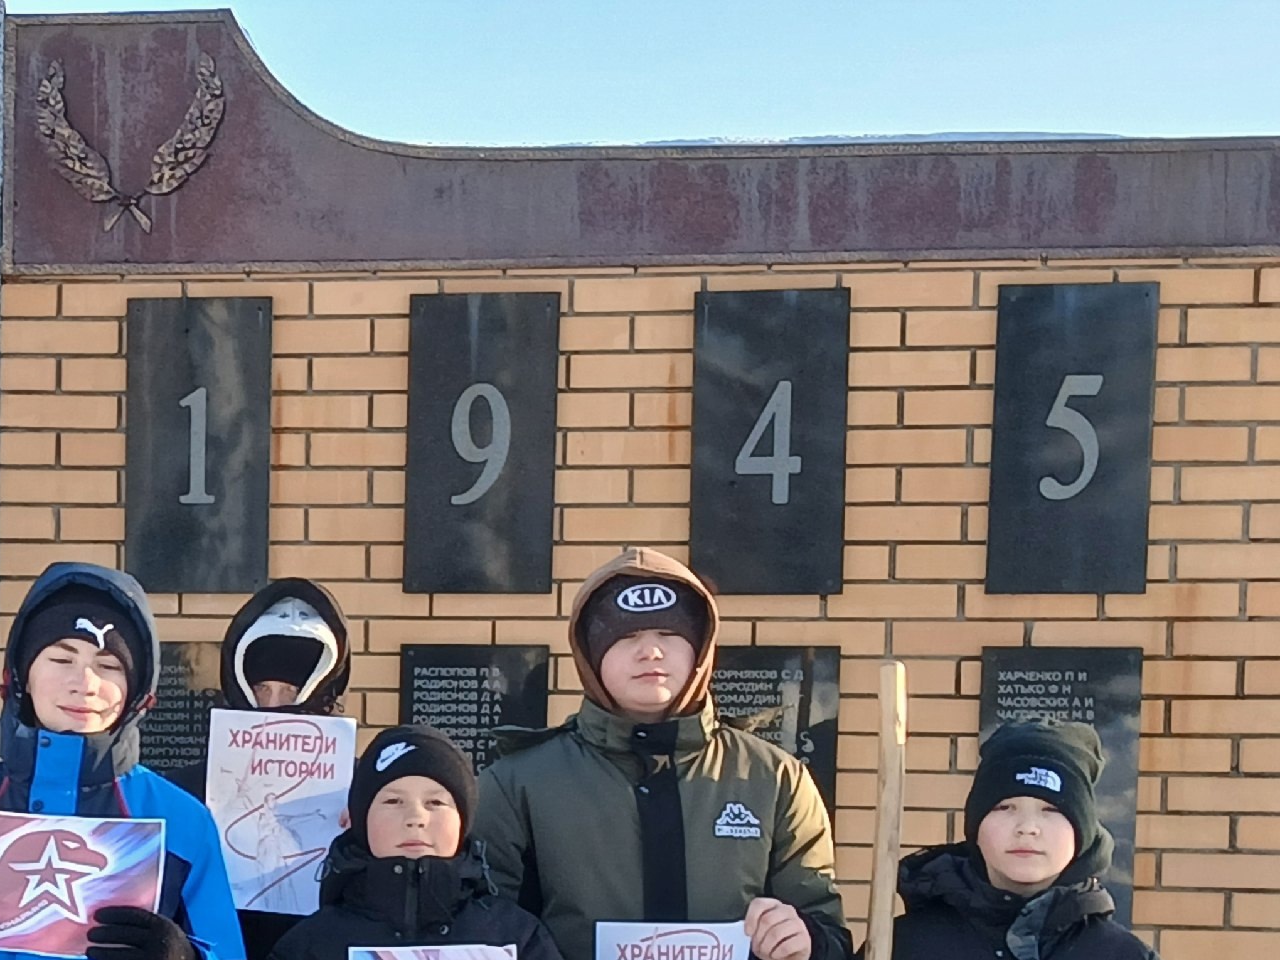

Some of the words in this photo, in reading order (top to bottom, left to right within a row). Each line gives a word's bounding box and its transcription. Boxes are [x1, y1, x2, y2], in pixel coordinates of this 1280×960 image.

[178, 387, 215, 505] 1
[451, 382, 511, 505] 9
[735, 380, 802, 504] 4
[1039, 374, 1104, 500] 5
[626, 588, 668, 606] KIA
[413, 667, 477, 677] РАСПОПОВ
[480, 667, 489, 677] П
[998, 671, 1062, 682] ХАРЧЕНКО
[1065, 671, 1075, 682] П
[413, 679, 478, 689] РОДИОНОВ
[481, 679, 490, 689] А
[998, 684, 1045, 694] ХАТЬКО
[413, 691, 478, 701] РОДИОНОВ
[480, 691, 491, 702] Д
[997, 696, 1069, 708] ЧАСОВСКИХ
[1072, 697, 1081, 708] А
[412, 703, 478, 713] РОДИОНОВ
[480, 703, 491, 714] Д
[493, 703, 502, 713] А
[412, 715, 477, 725] РОДИОНОВ
[228, 729, 337, 755] ХРАНИТЕЛИ
[251, 758, 335, 780] ИСТОРИИ
